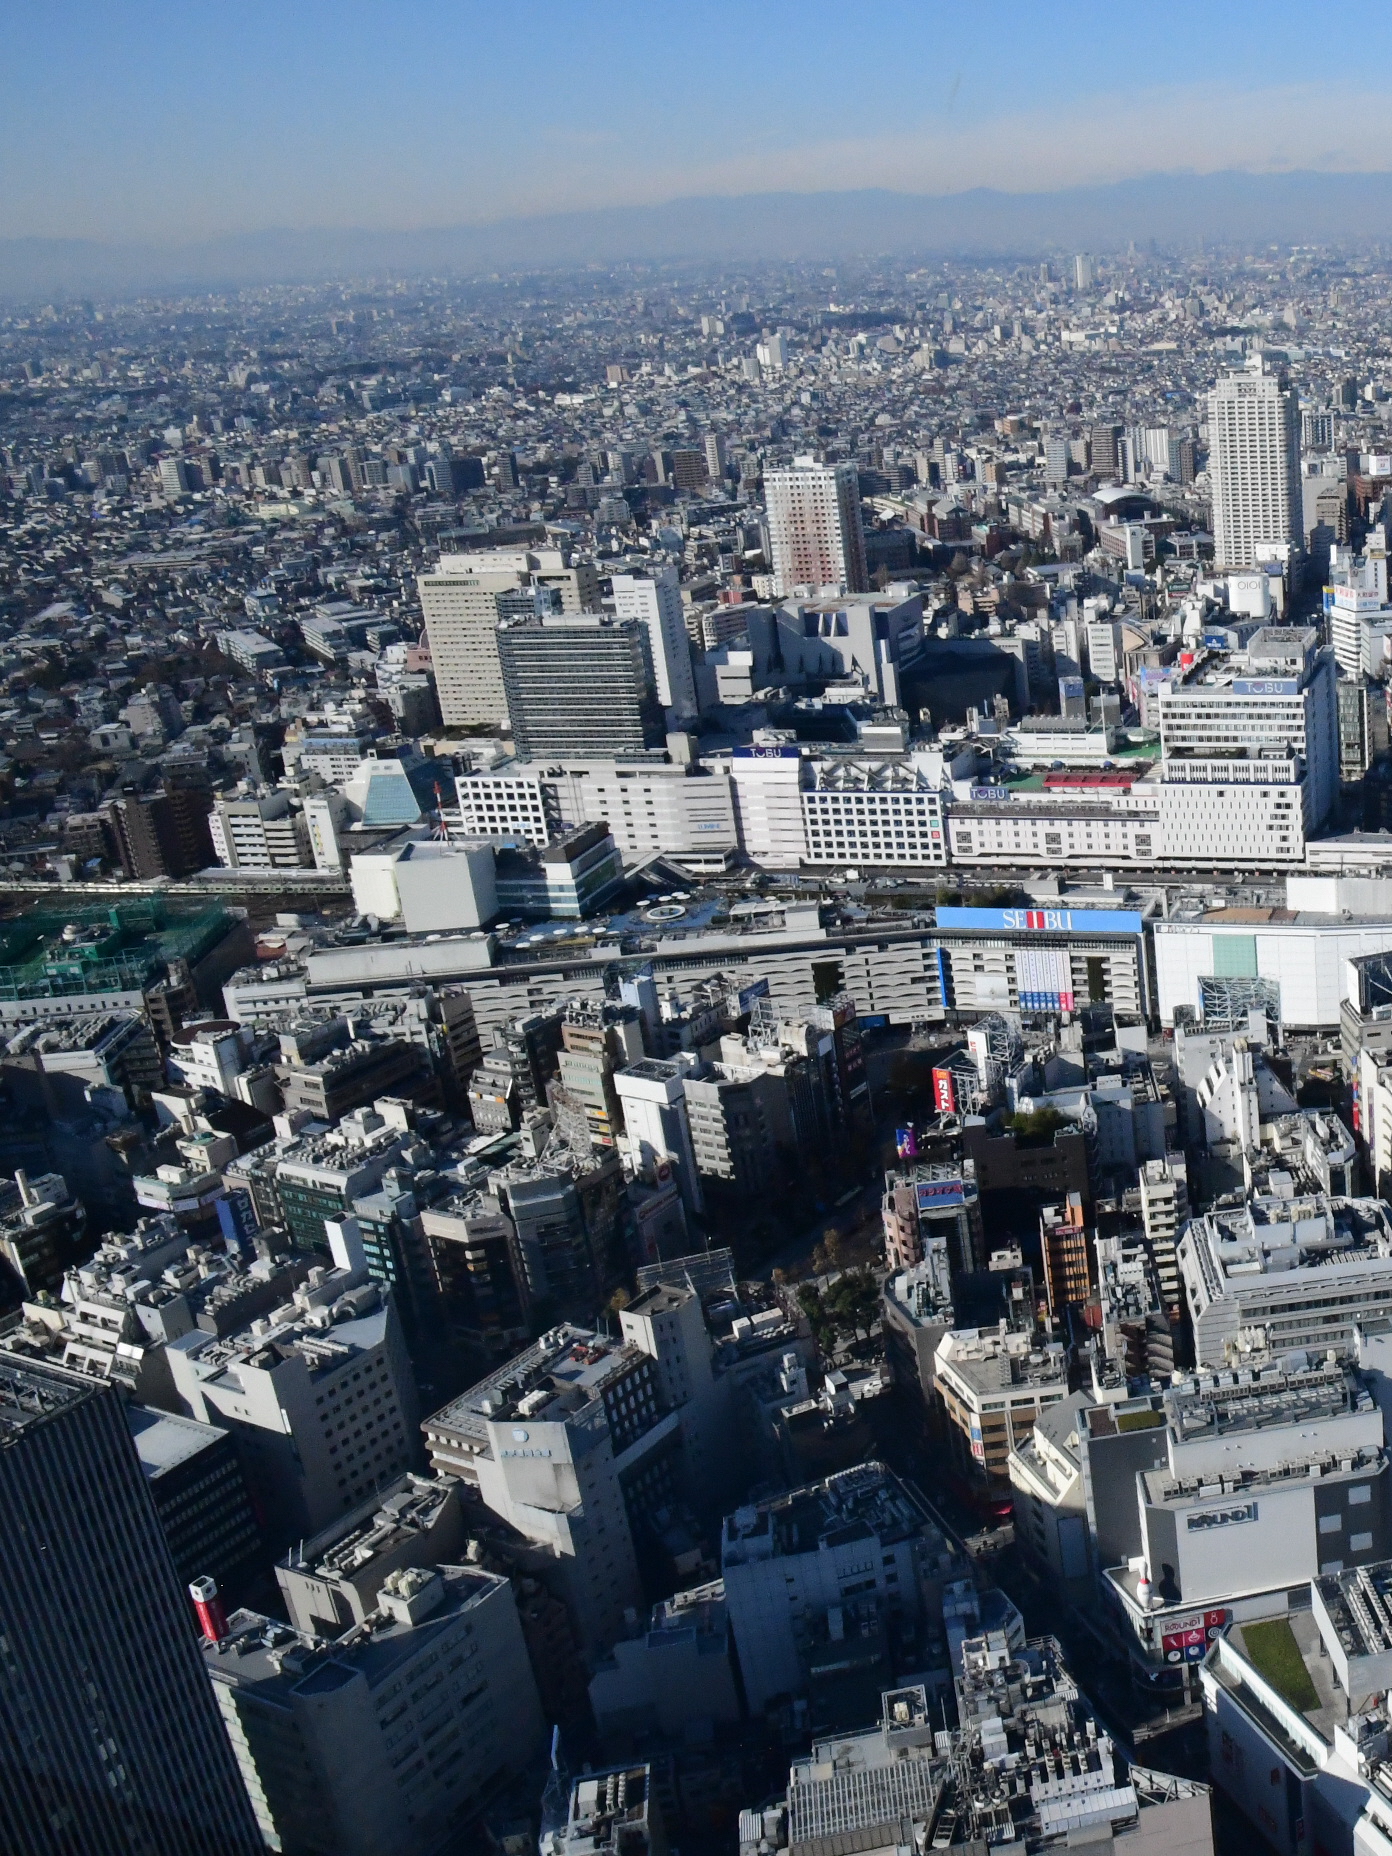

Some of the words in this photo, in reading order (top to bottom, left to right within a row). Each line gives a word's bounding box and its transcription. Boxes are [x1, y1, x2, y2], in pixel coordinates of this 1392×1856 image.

[1246, 682, 1283, 694] TOBU
[751, 748, 782, 758] TOBU
[971, 788, 1005, 800] TOBU
[1002, 910, 1073, 930] SEIBU
[938, 1079, 949, 1109] ガスト
